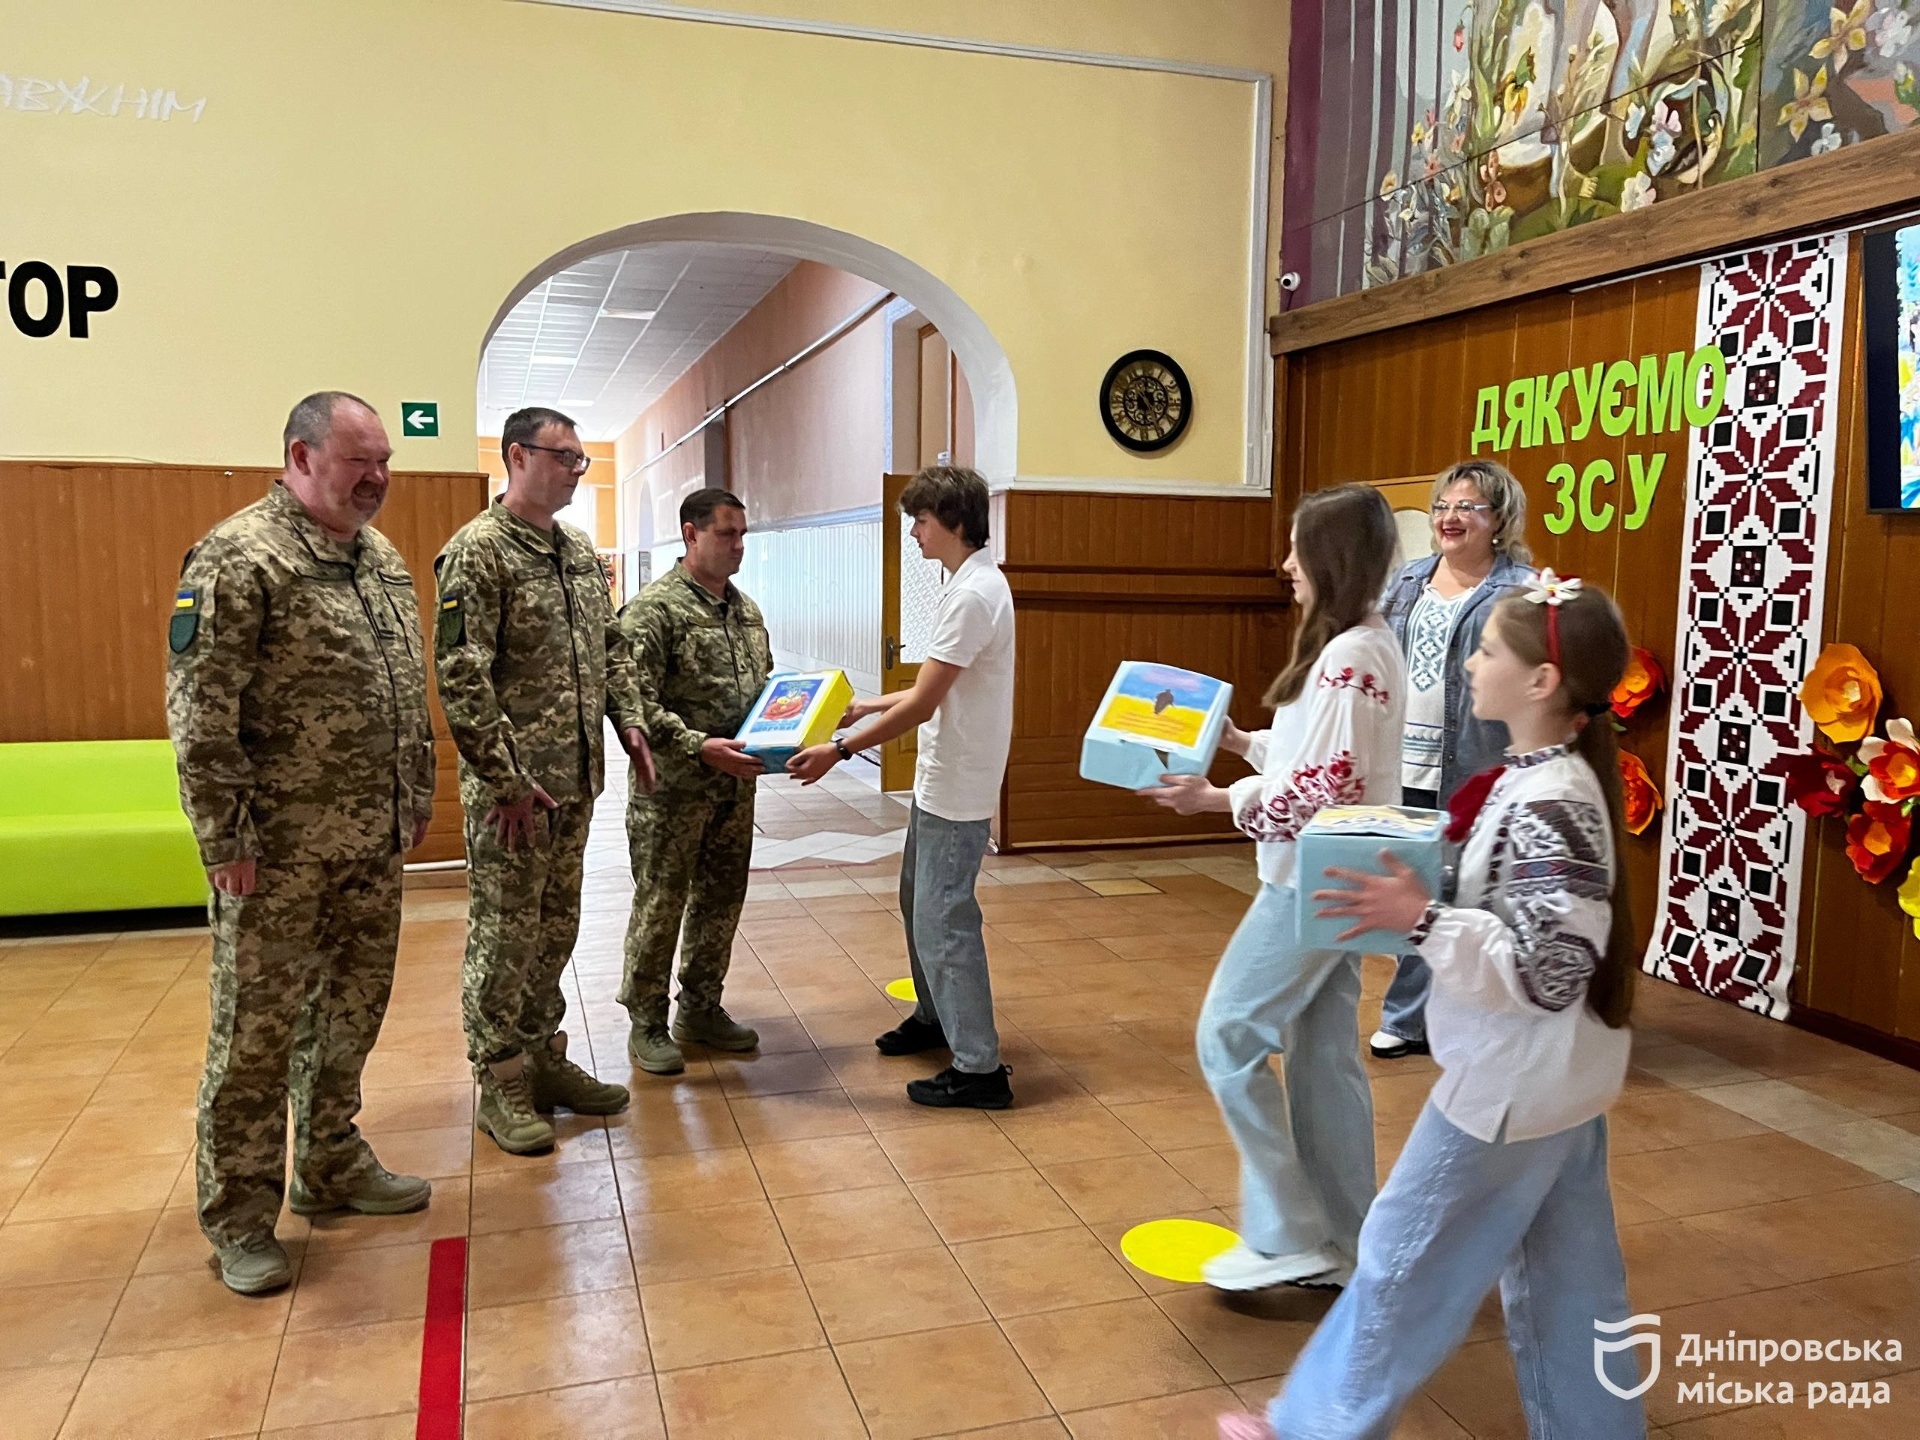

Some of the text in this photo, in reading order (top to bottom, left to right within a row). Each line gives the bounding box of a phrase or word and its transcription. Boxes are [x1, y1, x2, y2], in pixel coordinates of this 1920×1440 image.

[0, 260, 119, 339] ОР
[1471, 345, 1727, 455] ДЯКУЄМО
[1544, 453, 1667, 535] ЗСУ
